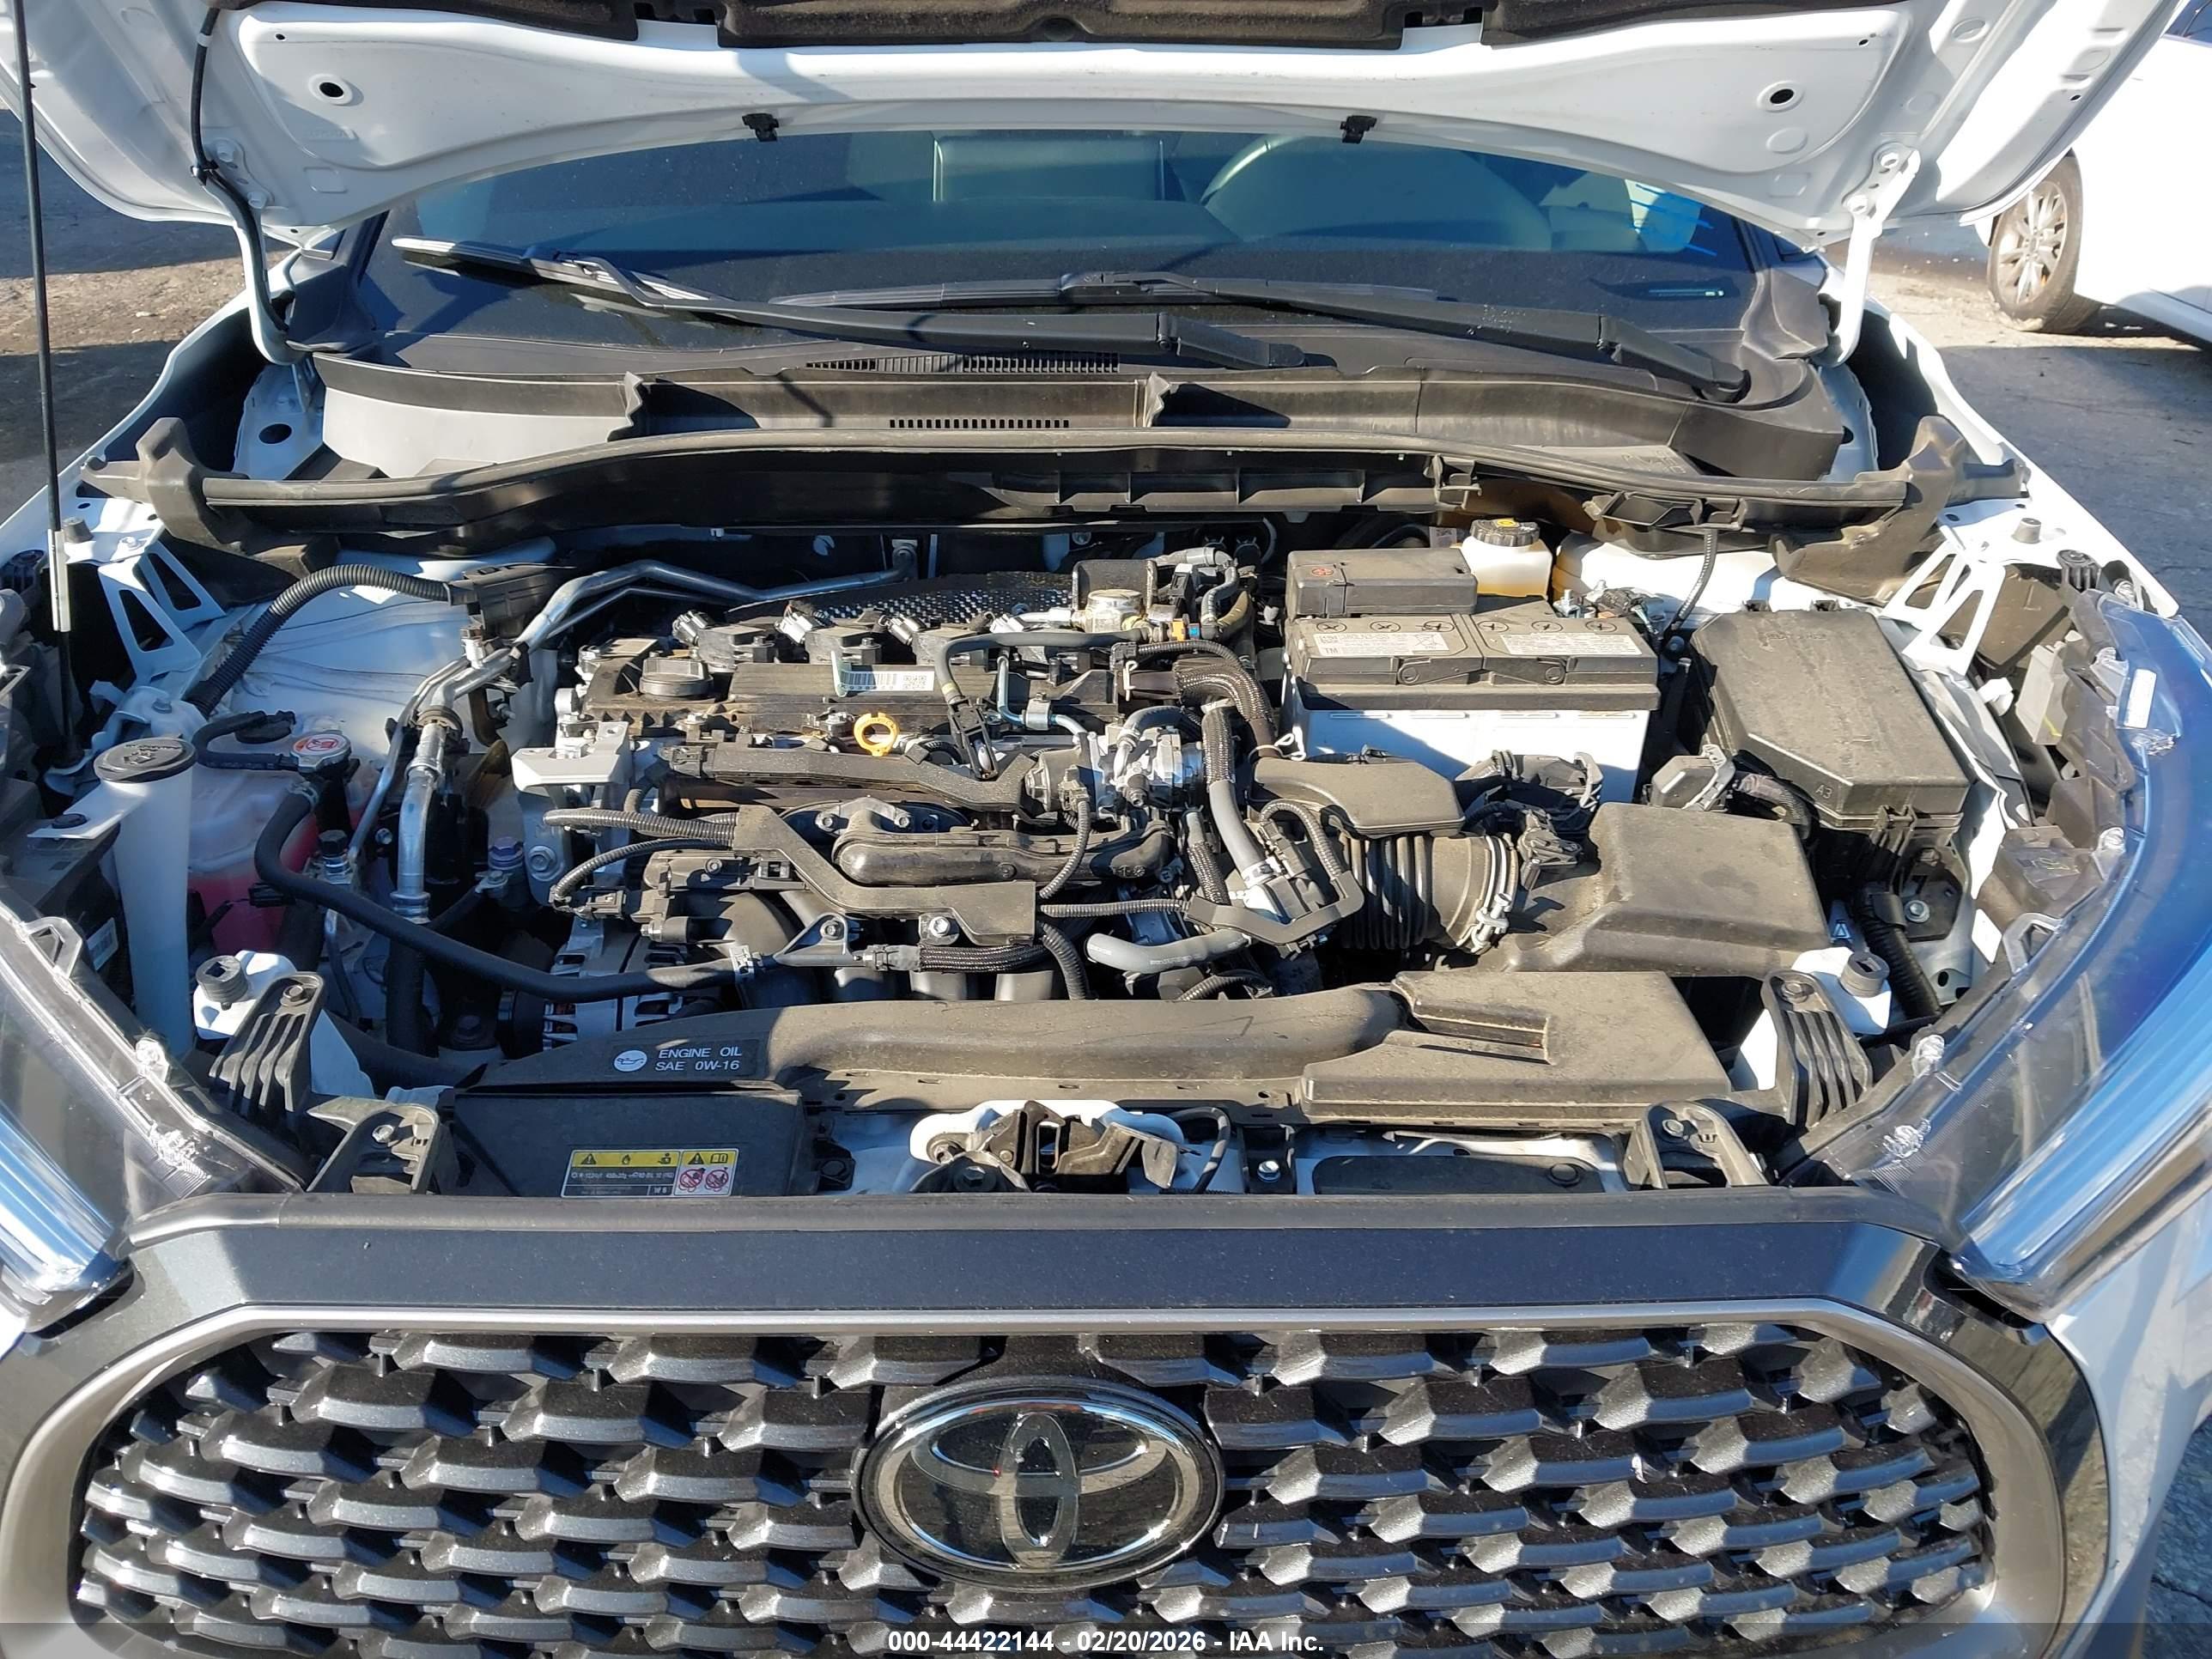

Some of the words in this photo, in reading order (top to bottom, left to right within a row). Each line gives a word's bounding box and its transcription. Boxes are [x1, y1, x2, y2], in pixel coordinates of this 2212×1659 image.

[1815, 784, 1832, 799] A3
[658, 1048, 711, 1059] ENGINE
[720, 1047, 743, 1057] OIL
[655, 1061, 685, 1071] SAE
[695, 1060, 740, 1071] 0W-16
